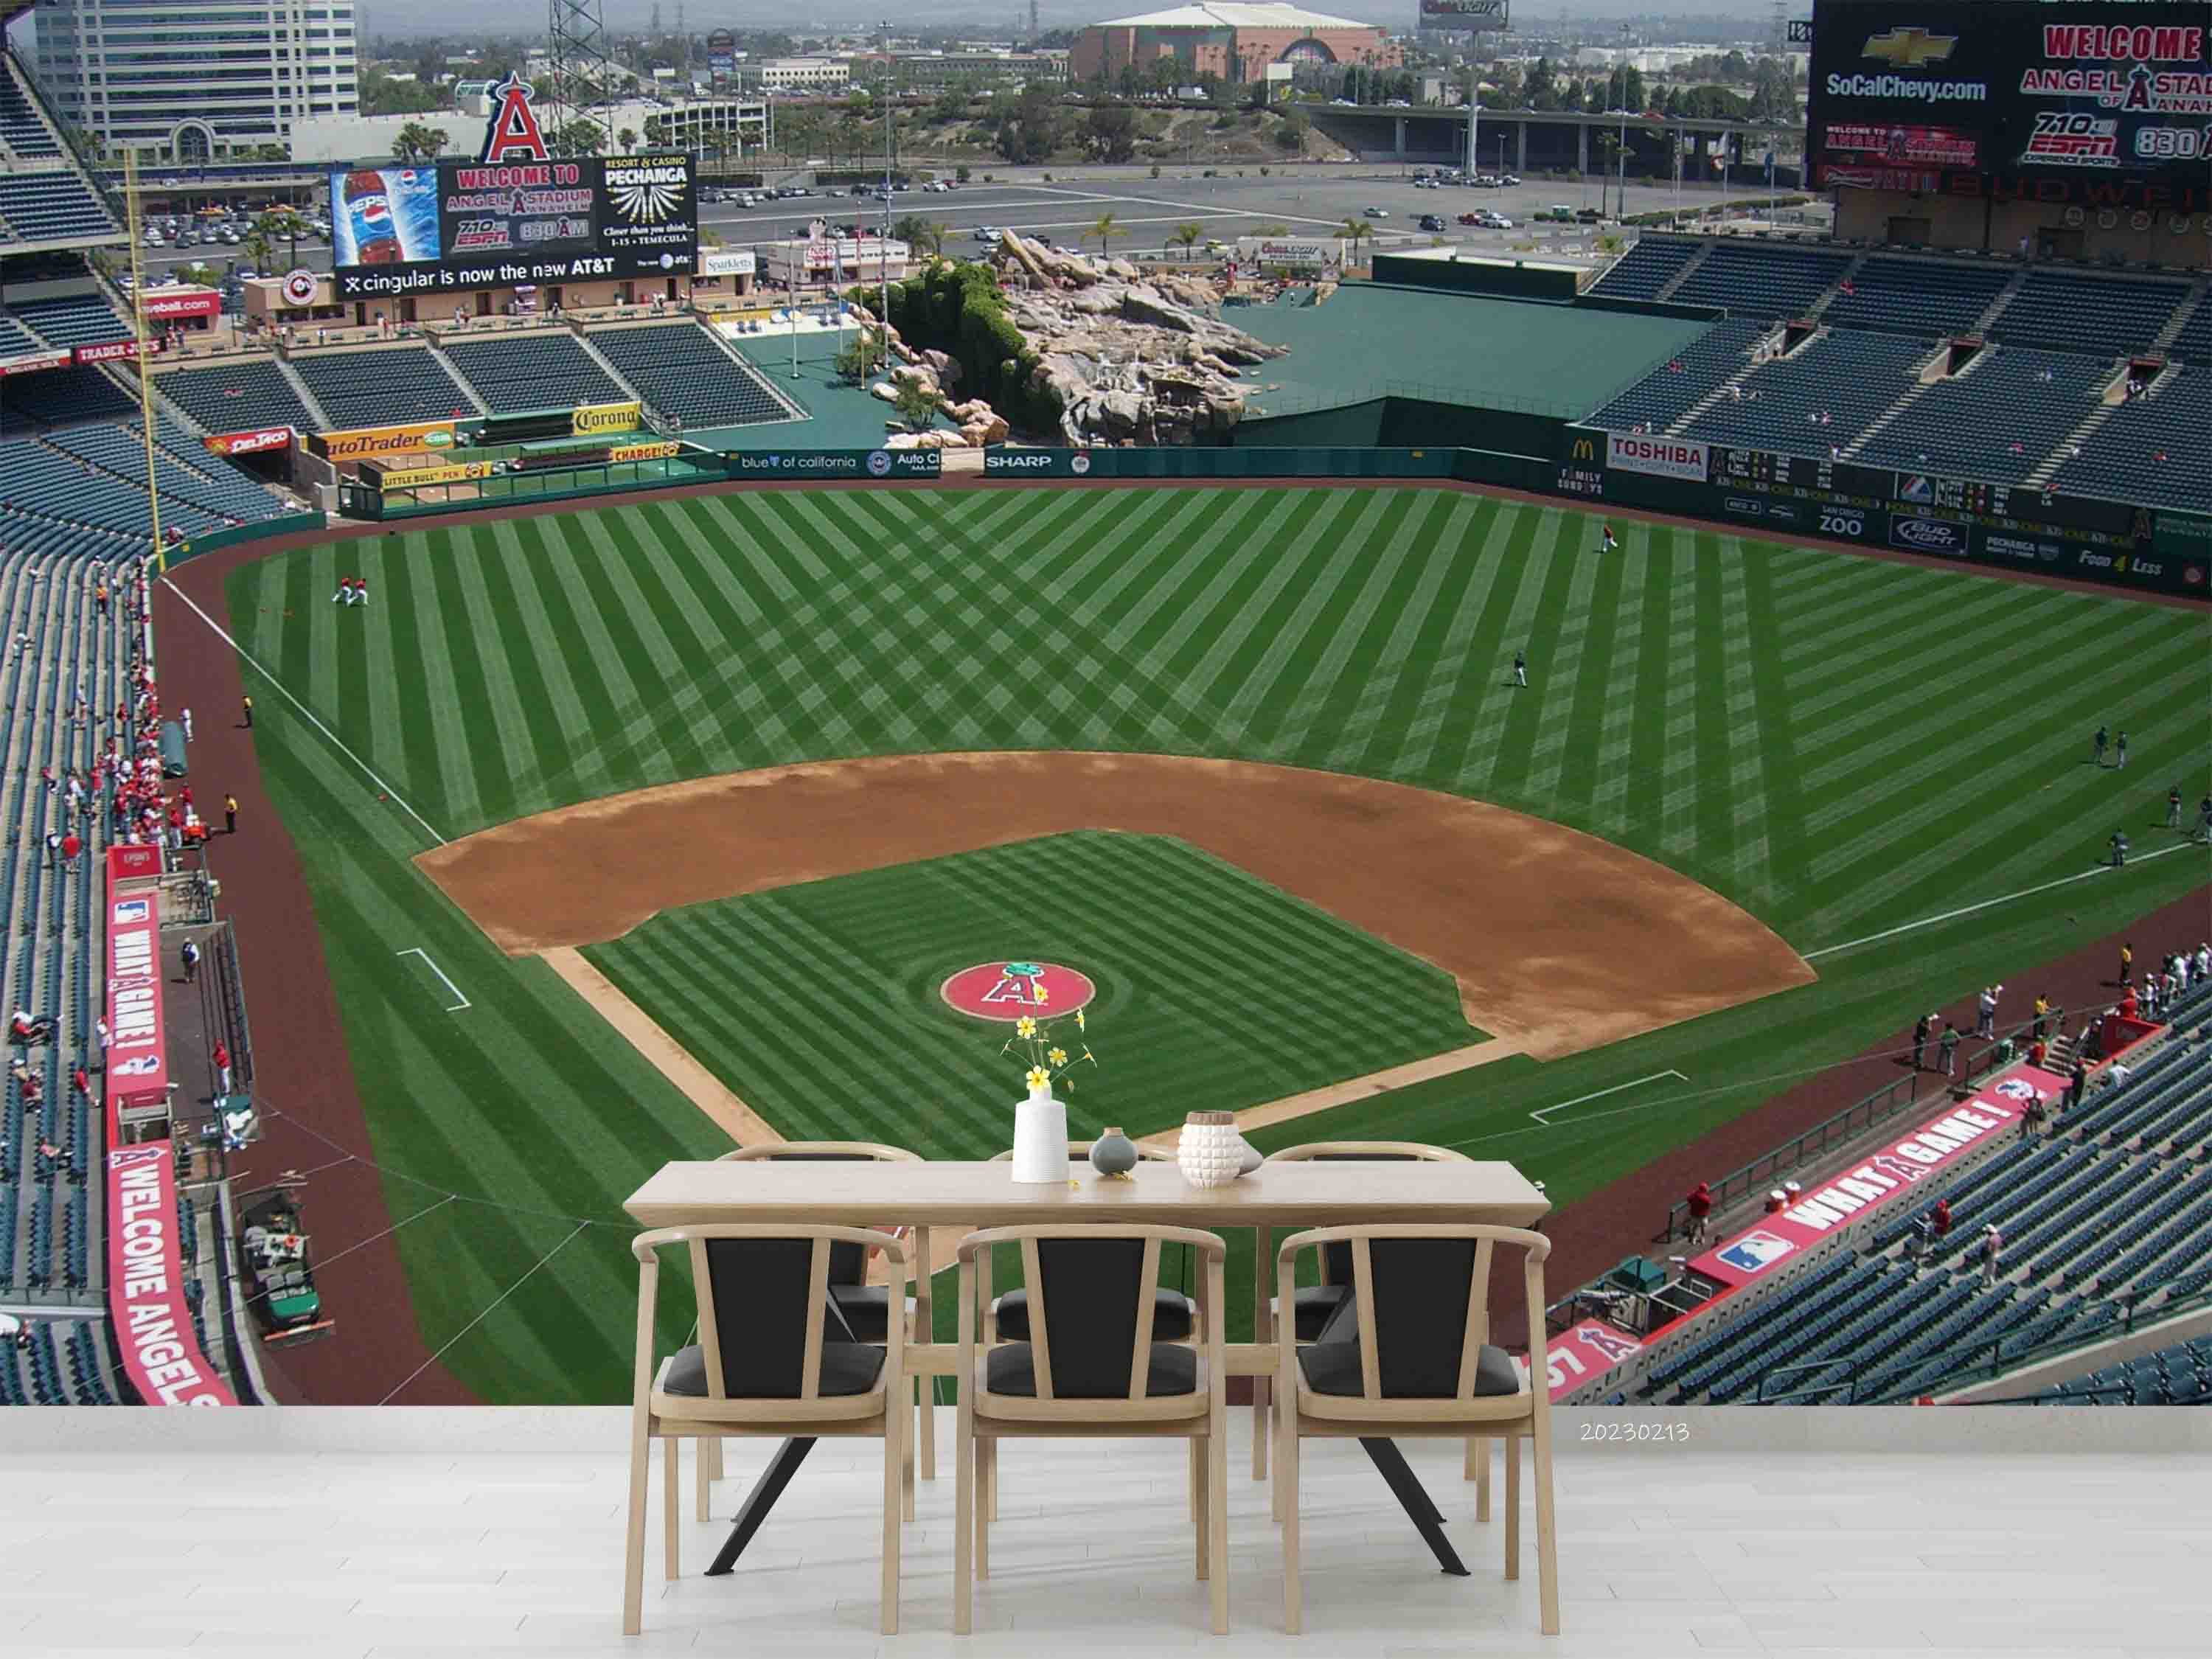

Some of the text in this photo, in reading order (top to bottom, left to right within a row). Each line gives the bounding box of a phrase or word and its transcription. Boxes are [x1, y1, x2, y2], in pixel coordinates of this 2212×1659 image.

[2043, 24, 2202, 62] WELCOME
[1826, 73, 1988, 103] SoCalChevy.com
[2020, 69, 2125, 95] ANGEL
[2100, 95, 2123, 108] OF
[2030, 133, 2118, 156] ESPN
[605, 156, 686, 169] RESORT & CASINO
[456, 164, 580, 189] WELCOME TO
[605, 167, 687, 185] PECHANGA
[446, 193, 509, 212] ANGEL
[526, 188, 593, 204] STADIUM
[456, 231, 509, 247] ESPN
[639, 234, 688, 245] TEMECULA
[363, 257, 615, 295] cingular is now the new AT&T
[80, 345, 126, 361] TRADER
[576, 409, 636, 431] Corona
[325, 433, 423, 455] utoTrader
[1614, 438, 1702, 466] TOSHIBA
[742, 455, 856, 468] blue of california
[897, 453, 924, 465] Auto
[986, 456, 1052, 467] SHARP
[384, 475, 413, 487] LITTLE
[442, 470, 460, 479] PEN
[1818, 514, 1863, 536] ZOO
[1911, 521, 1952, 537] BUD
[1906, 529, 1958, 546] LIGHT
[2112, 554, 2129, 572] 4
[1782, 1165, 1901, 1231] WHAT
[119, 1164, 168, 1300] WELCOME
